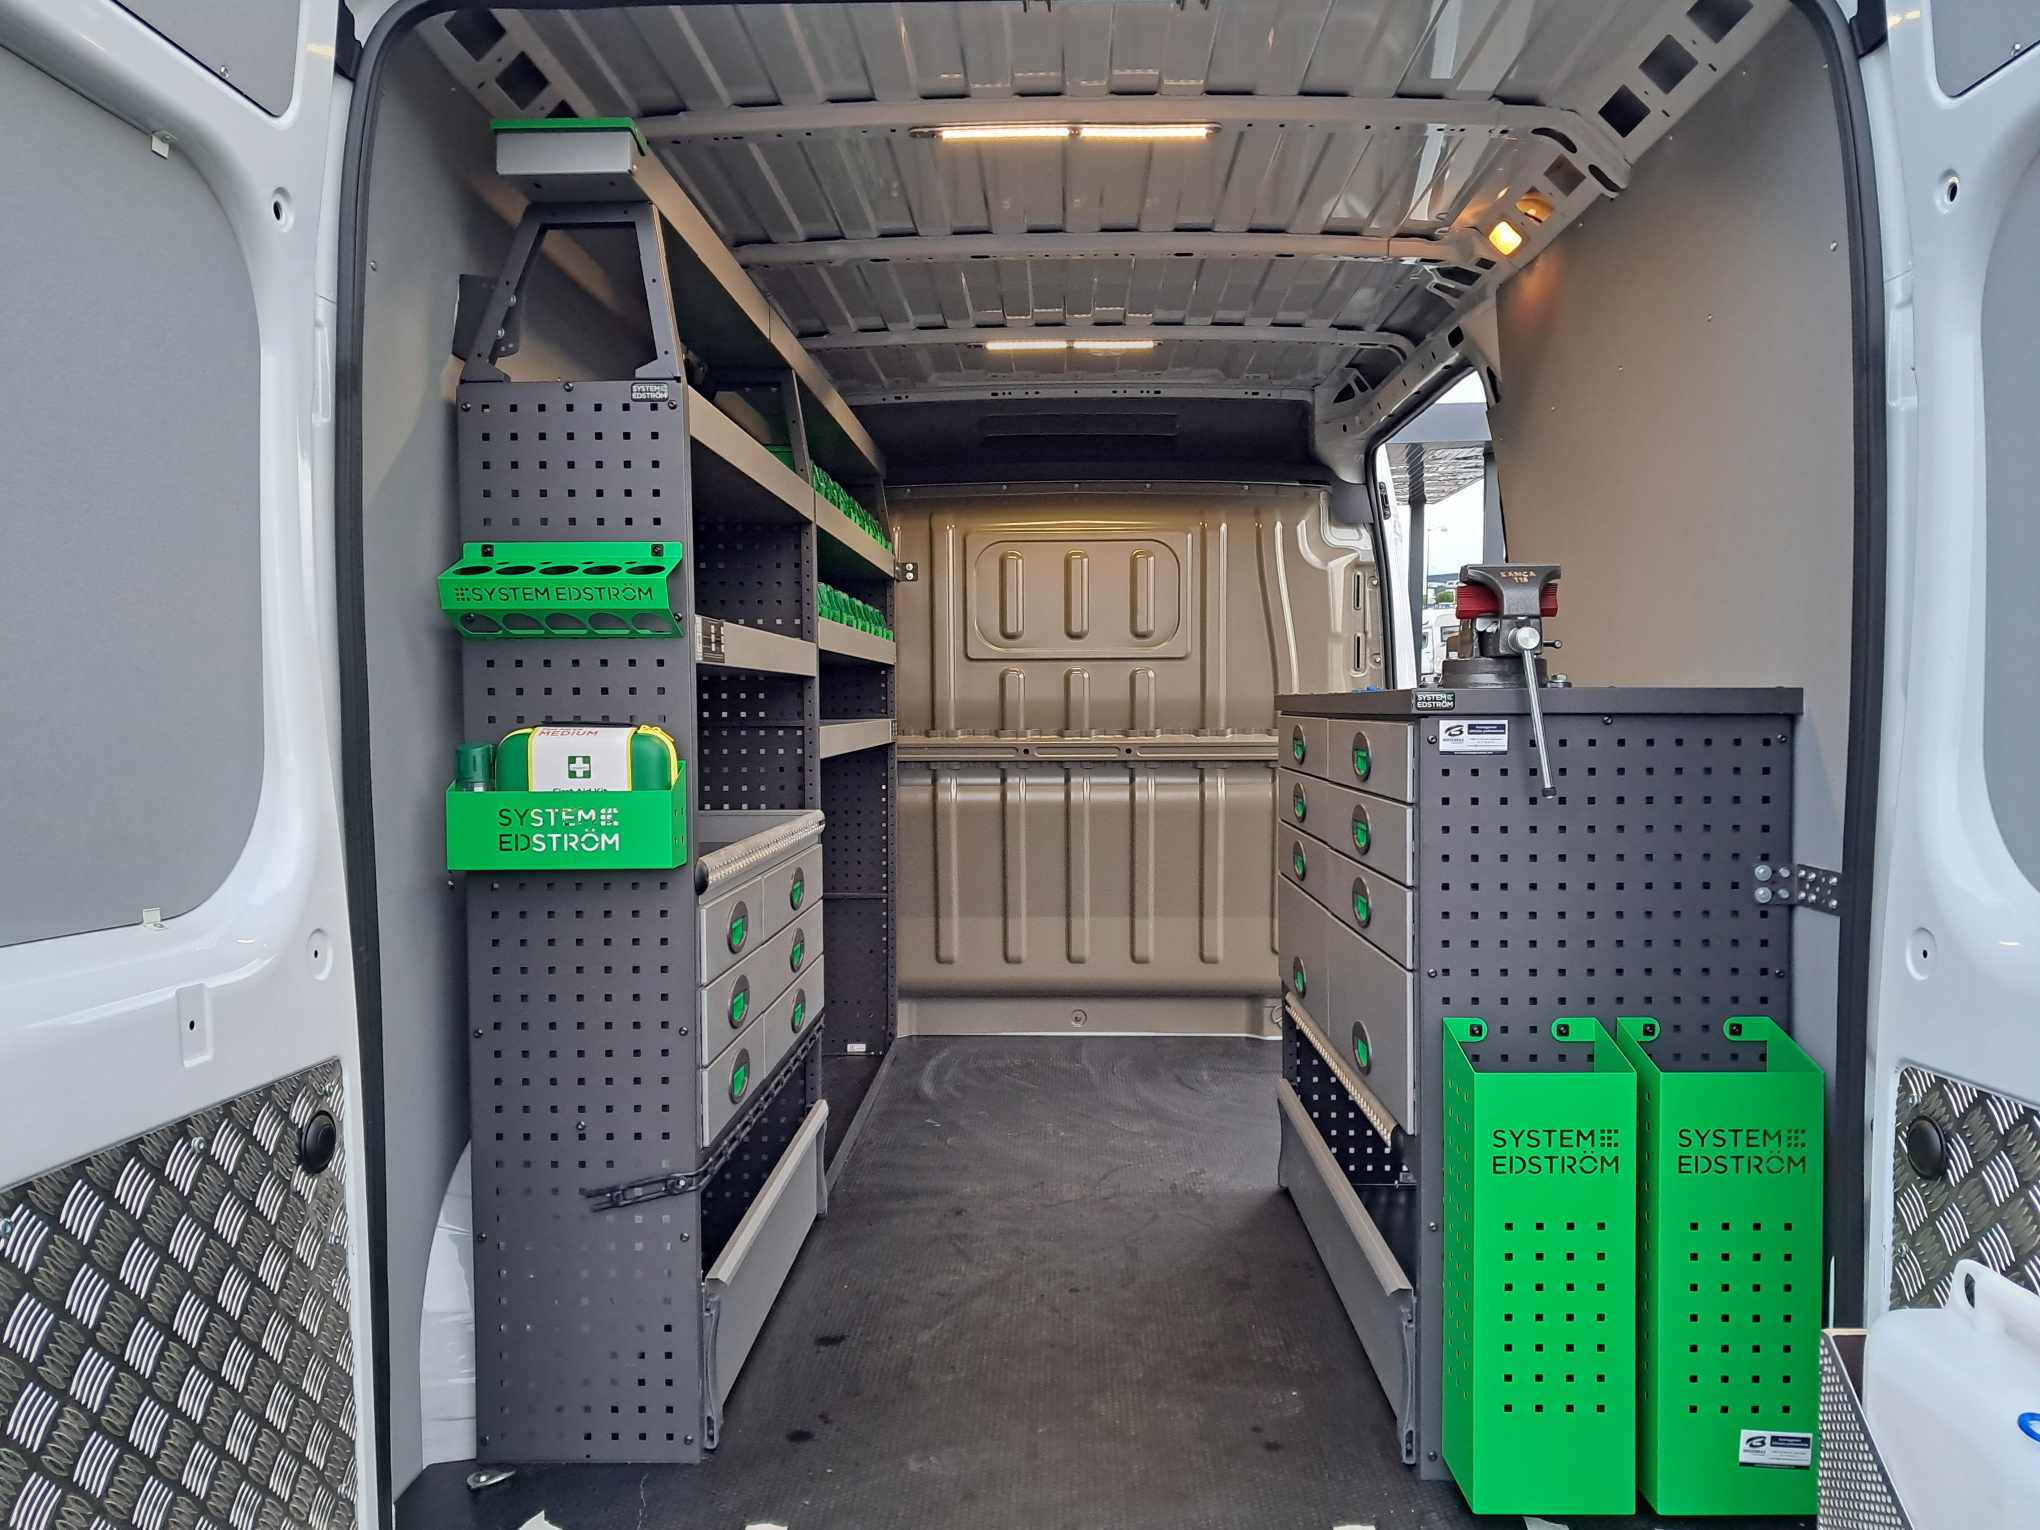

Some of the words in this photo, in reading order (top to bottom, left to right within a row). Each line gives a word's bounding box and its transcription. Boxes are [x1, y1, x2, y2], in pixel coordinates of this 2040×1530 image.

[471, 587, 550, 602] SYSTEM
[556, 584, 654, 602] EDSTRÖM
[1417, 700, 1454, 708] EDSTRÖM
[498, 808, 597, 827] SYSTEM
[498, 829, 620, 852] EDSTRÖM
[1492, 1129, 1595, 1148] SYSTEM
[1678, 1129, 1782, 1148] SYSTEM
[1492, 1150, 1619, 1175] EDSTRÖM
[1678, 1150, 1807, 1175] EDSTRÖM
